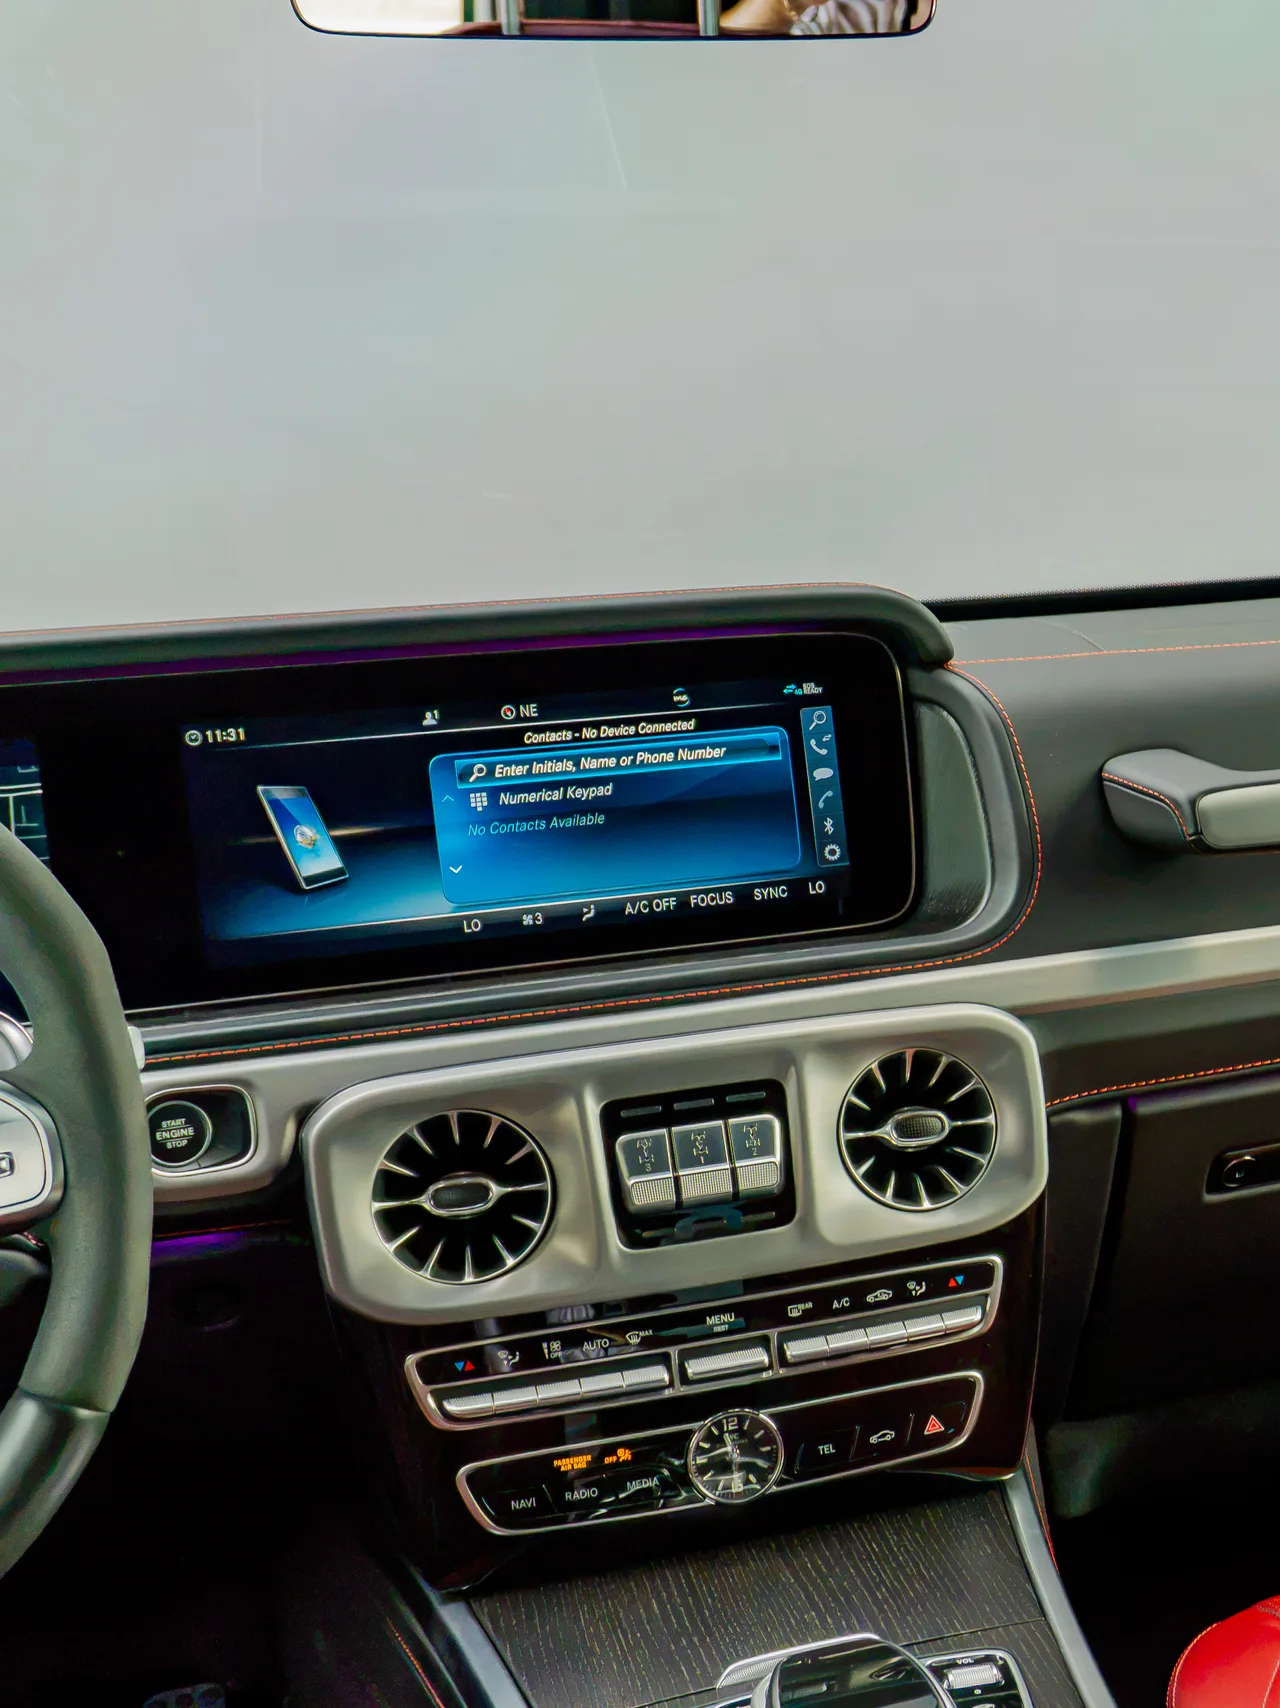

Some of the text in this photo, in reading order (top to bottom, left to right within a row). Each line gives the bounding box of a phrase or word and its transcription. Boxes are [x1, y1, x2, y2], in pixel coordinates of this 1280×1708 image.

[803, 686, 823, 695] READY
[519, 703, 539, 718] NE
[205, 727, 246, 743] 11:31
[524, 729, 572, 744] Contacts
[581, 726, 598, 740] No
[600, 723, 636, 738] Device
[638, 718, 695, 734] Connected
[494, 746, 726, 778] Enter Initials, Name or Phone Number
[499, 782, 613, 805] Numerical Keypad
[468, 812, 605, 837] No Contacts Available
[753, 885, 788, 901] SYNC
[808, 880, 826, 895] LO
[690, 891, 733, 908] FOCUS
[625, 897, 677, 916] A/C OFF
[534, 912, 543, 925] 3
[463, 918, 481, 933] LO
[161, 1118, 186, 1128] START
[155, 1127, 195, 1140] ENGINE
[166, 1140, 188, 1149] STOP
[832, 1297, 850, 1310] A/C
[706, 1312, 735, 1326] MENU
[639, 1329, 654, 1337] MAX
[713, 1325, 729, 1333] REST
[582, 1338, 609, 1351] AUTO
[722, 1417, 739, 1431] 12
[817, 1443, 836, 1455] TEL
[553, 1454, 592, 1467] PASSENGER
[604, 1455, 617, 1464] OFF
[560, 1461, 587, 1472] AIR BAG
[626, 1476, 660, 1491] MEDIA
[565, 1487, 598, 1501] RADIO
[511, 1497, 536, 1510] NAVI
[956, 1657, 975, 1665] VOL
